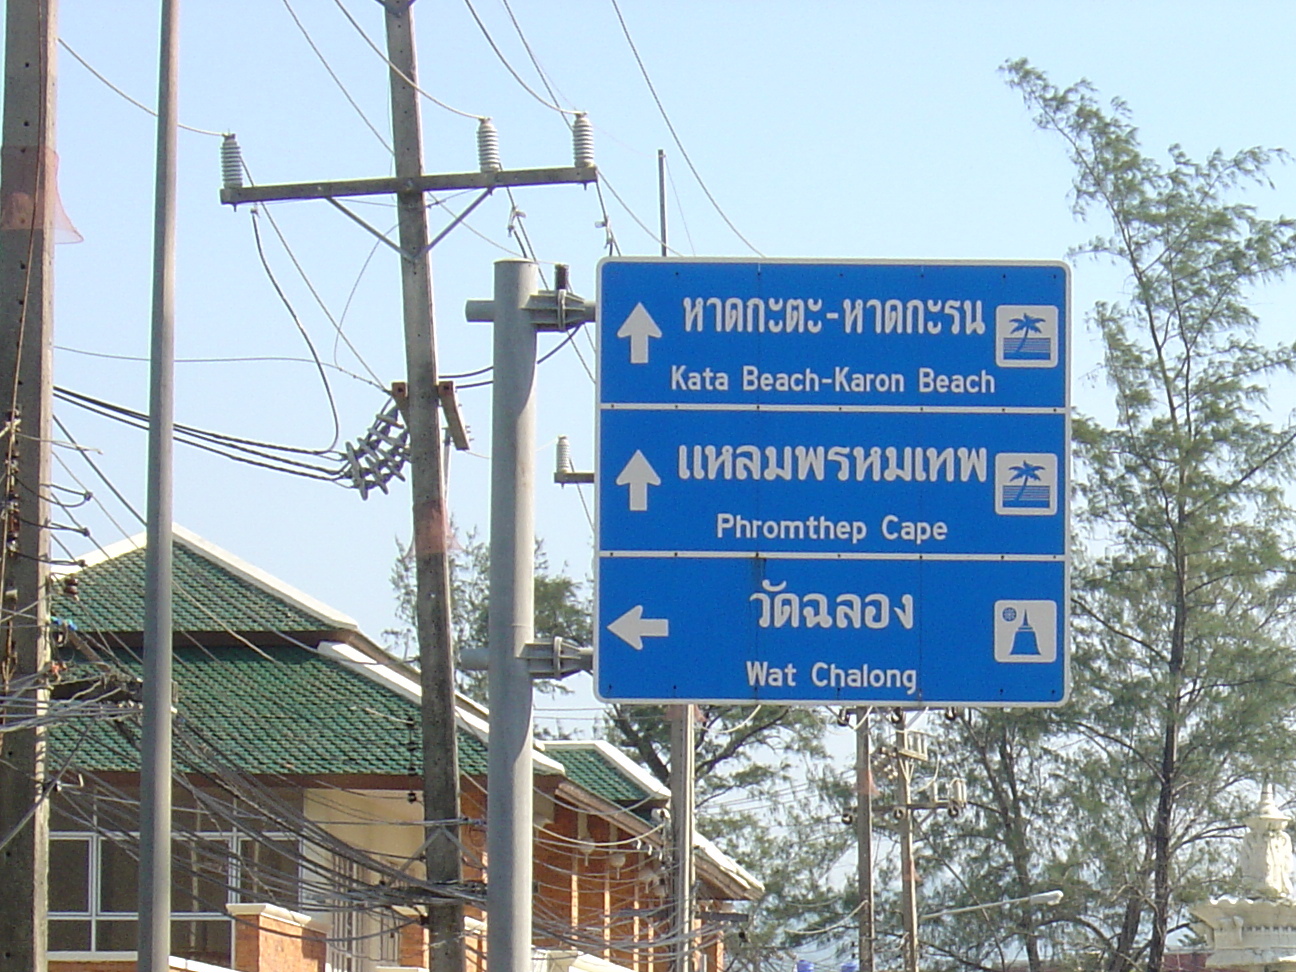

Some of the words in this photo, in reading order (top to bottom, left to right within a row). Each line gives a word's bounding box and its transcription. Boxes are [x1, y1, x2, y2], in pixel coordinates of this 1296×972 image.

[682, 297, 986, 335] หาดกะตะ-หาดกะรน
[671, 365, 729, 391] Kata
[742, 366, 905, 393] Beach-Karon
[918, 368, 996, 394] Beach
[678, 444, 987, 483] แหลมพรหมเทพ
[717, 513, 867, 544] Phromthep
[881, 514, 948, 545] Cape
[749, 579, 914, 630] วัดฉลอง
[746, 660, 797, 687] Wat
[811, 661, 917, 695] Chalong
